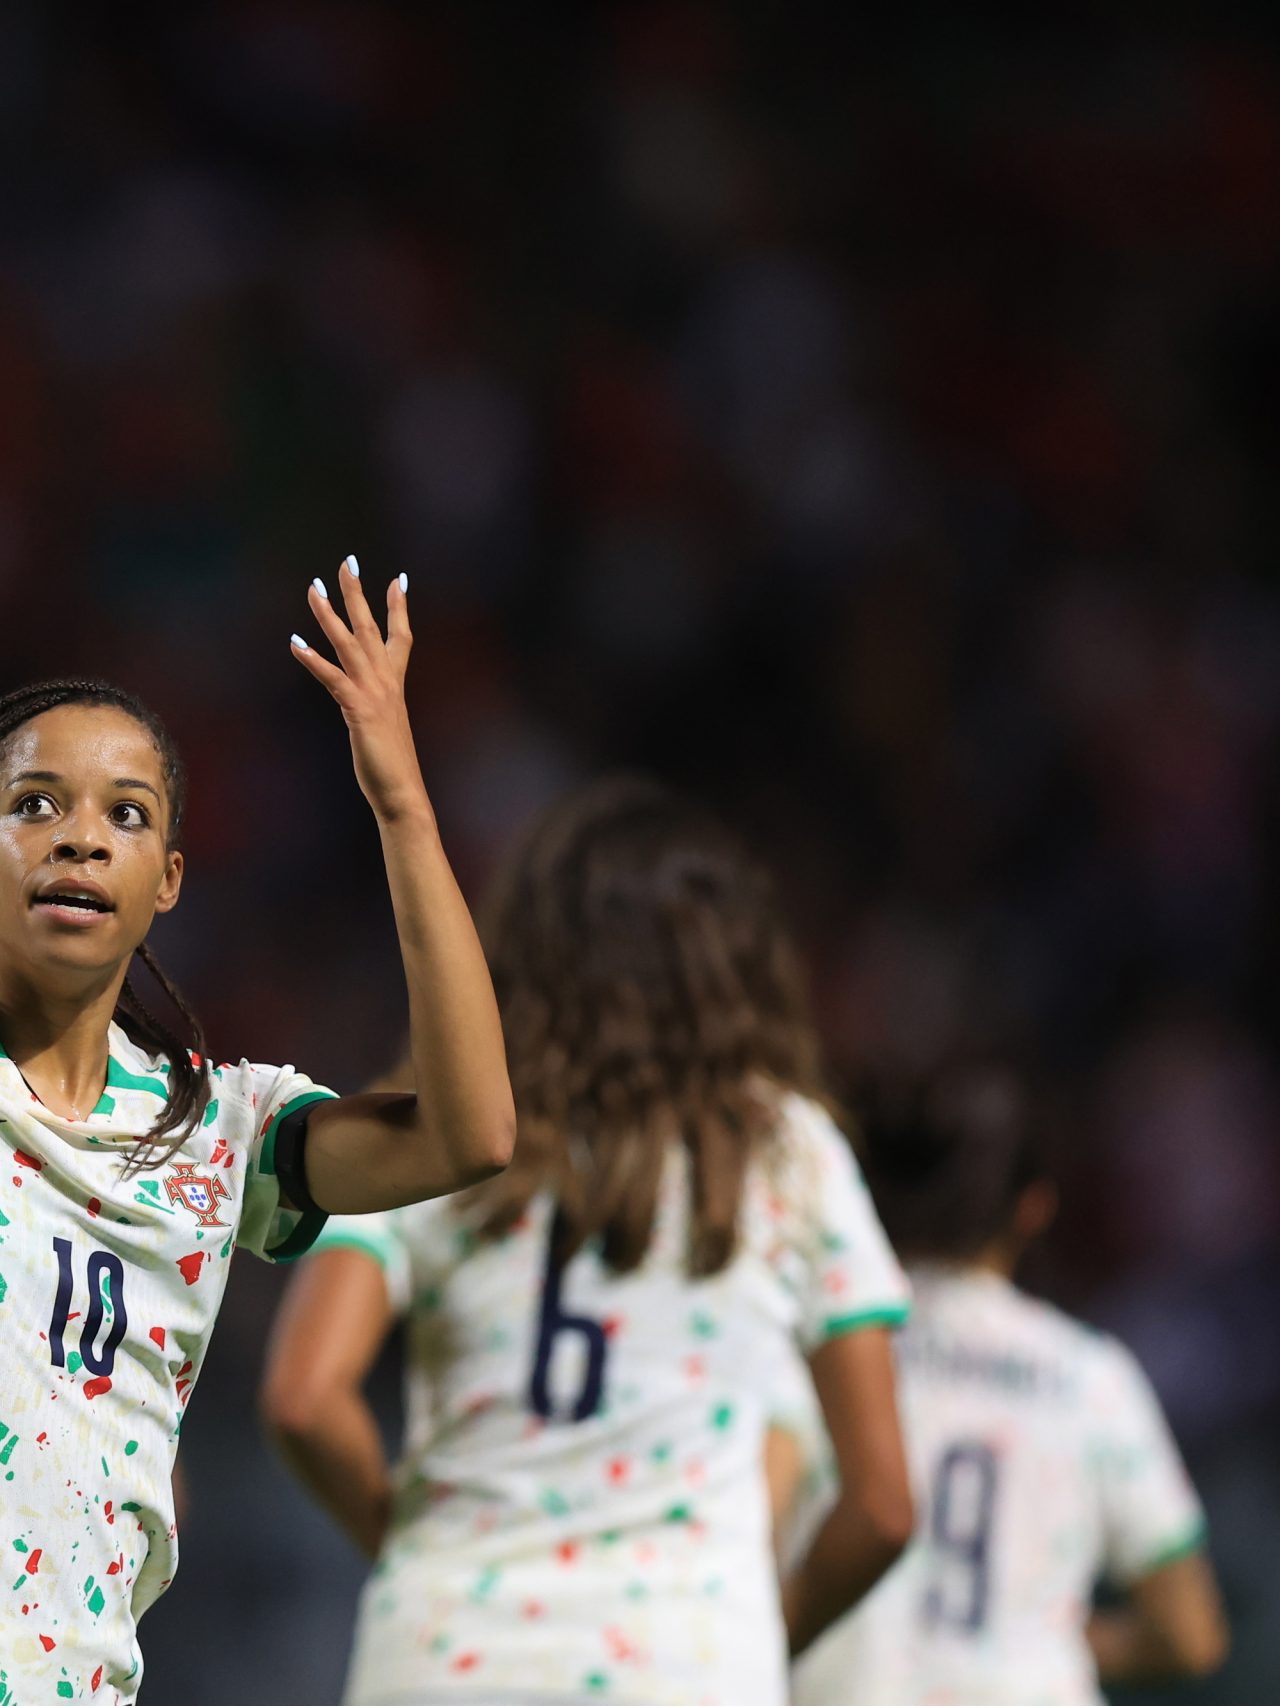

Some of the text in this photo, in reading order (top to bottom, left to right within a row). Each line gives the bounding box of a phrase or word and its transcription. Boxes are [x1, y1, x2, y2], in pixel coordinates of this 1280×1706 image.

[50, 1237, 128, 1377] 10
[530, 1204, 606, 1423] 6
[924, 1438, 998, 1637] 9
